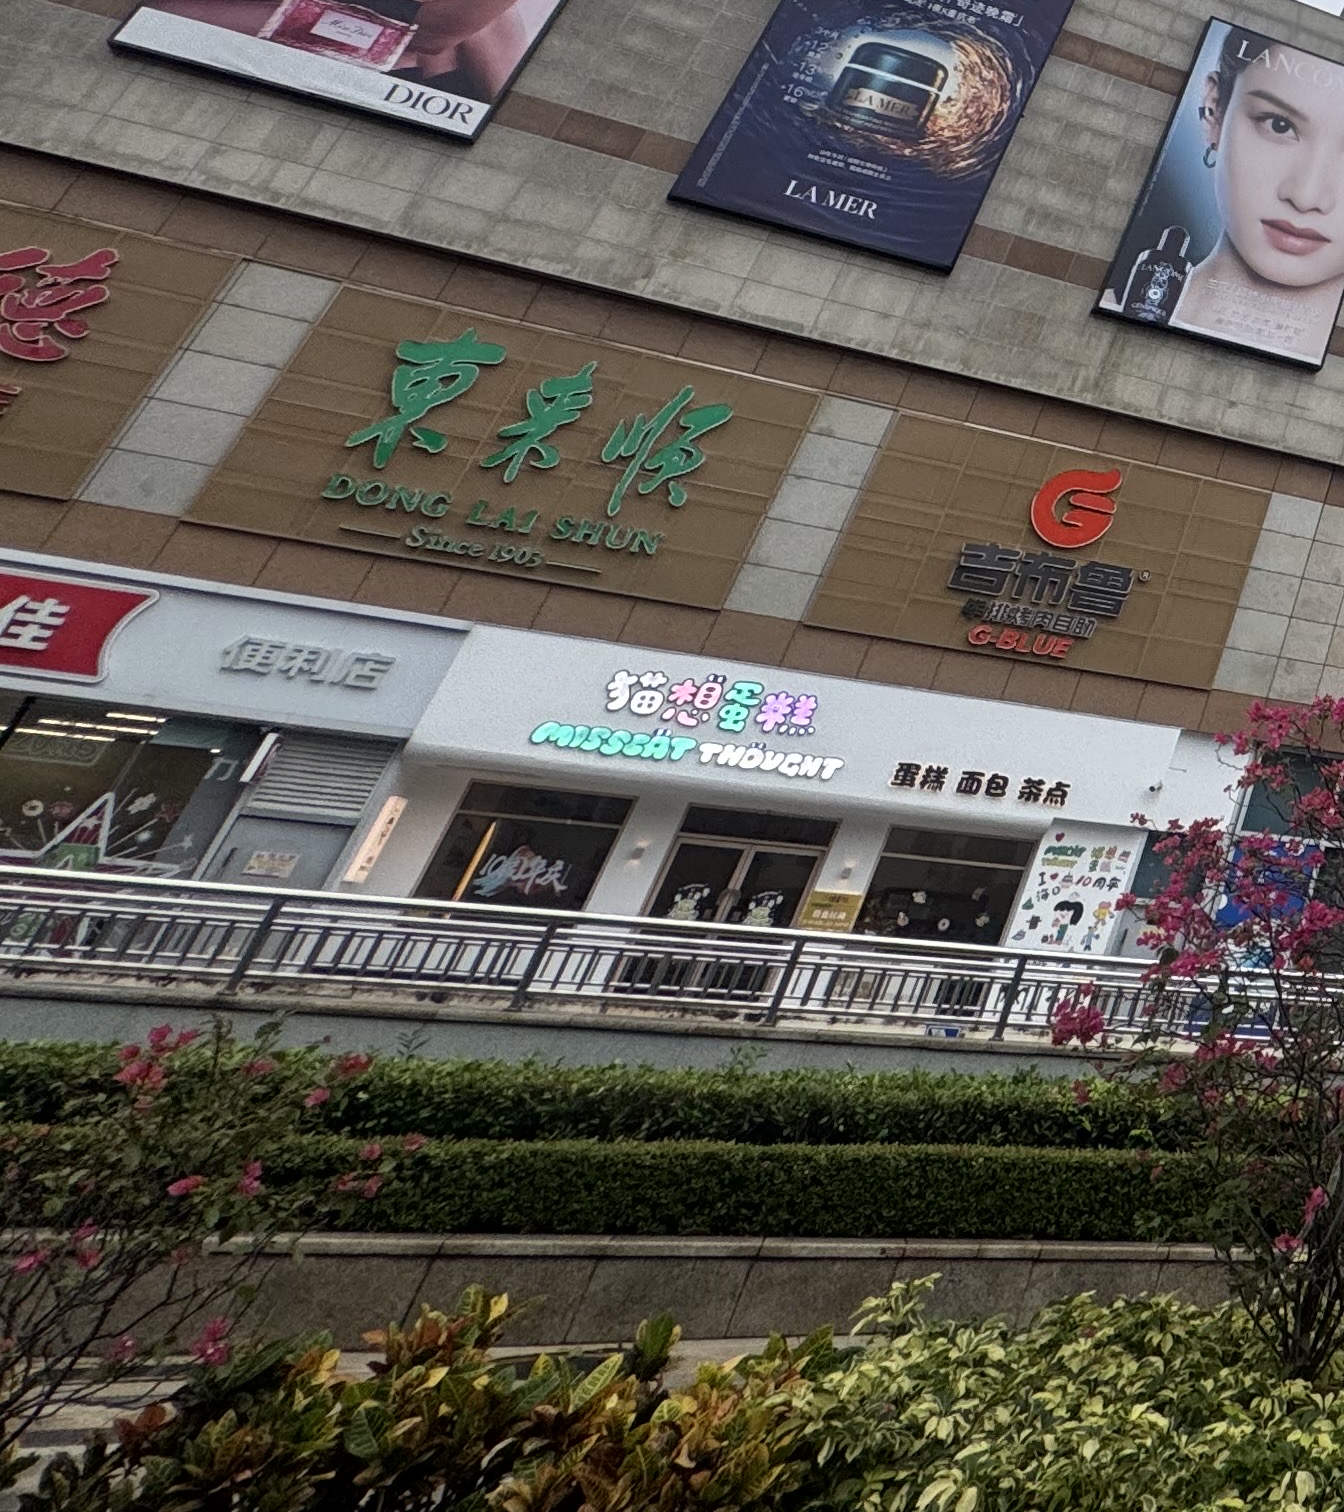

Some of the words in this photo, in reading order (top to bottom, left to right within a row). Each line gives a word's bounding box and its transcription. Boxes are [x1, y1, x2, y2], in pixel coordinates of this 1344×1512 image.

[384, 84, 474, 124] DIOR
[857, 88, 875, 107] LA
[876, 93, 912, 116] MER
[784, 179, 818, 204] LA
[823, 190, 879, 220] MER
[321, 473, 452, 518] DONG
[464, 500, 541, 535] LAI
[550, 516, 665, 556] SHUN
[405, 524, 485, 559] Since
[947, 541, 1136, 618] 吉布鲁
[219, 634, 398, 689] 便利店
[968, 623, 1075, 659] G-BLUE
[605, 670, 818, 735] 猫想蛋糕
[890, 761, 949, 792] 蛋糕
[955, 770, 1010, 798] 面包
[1017, 776, 1071, 807] 茶点
